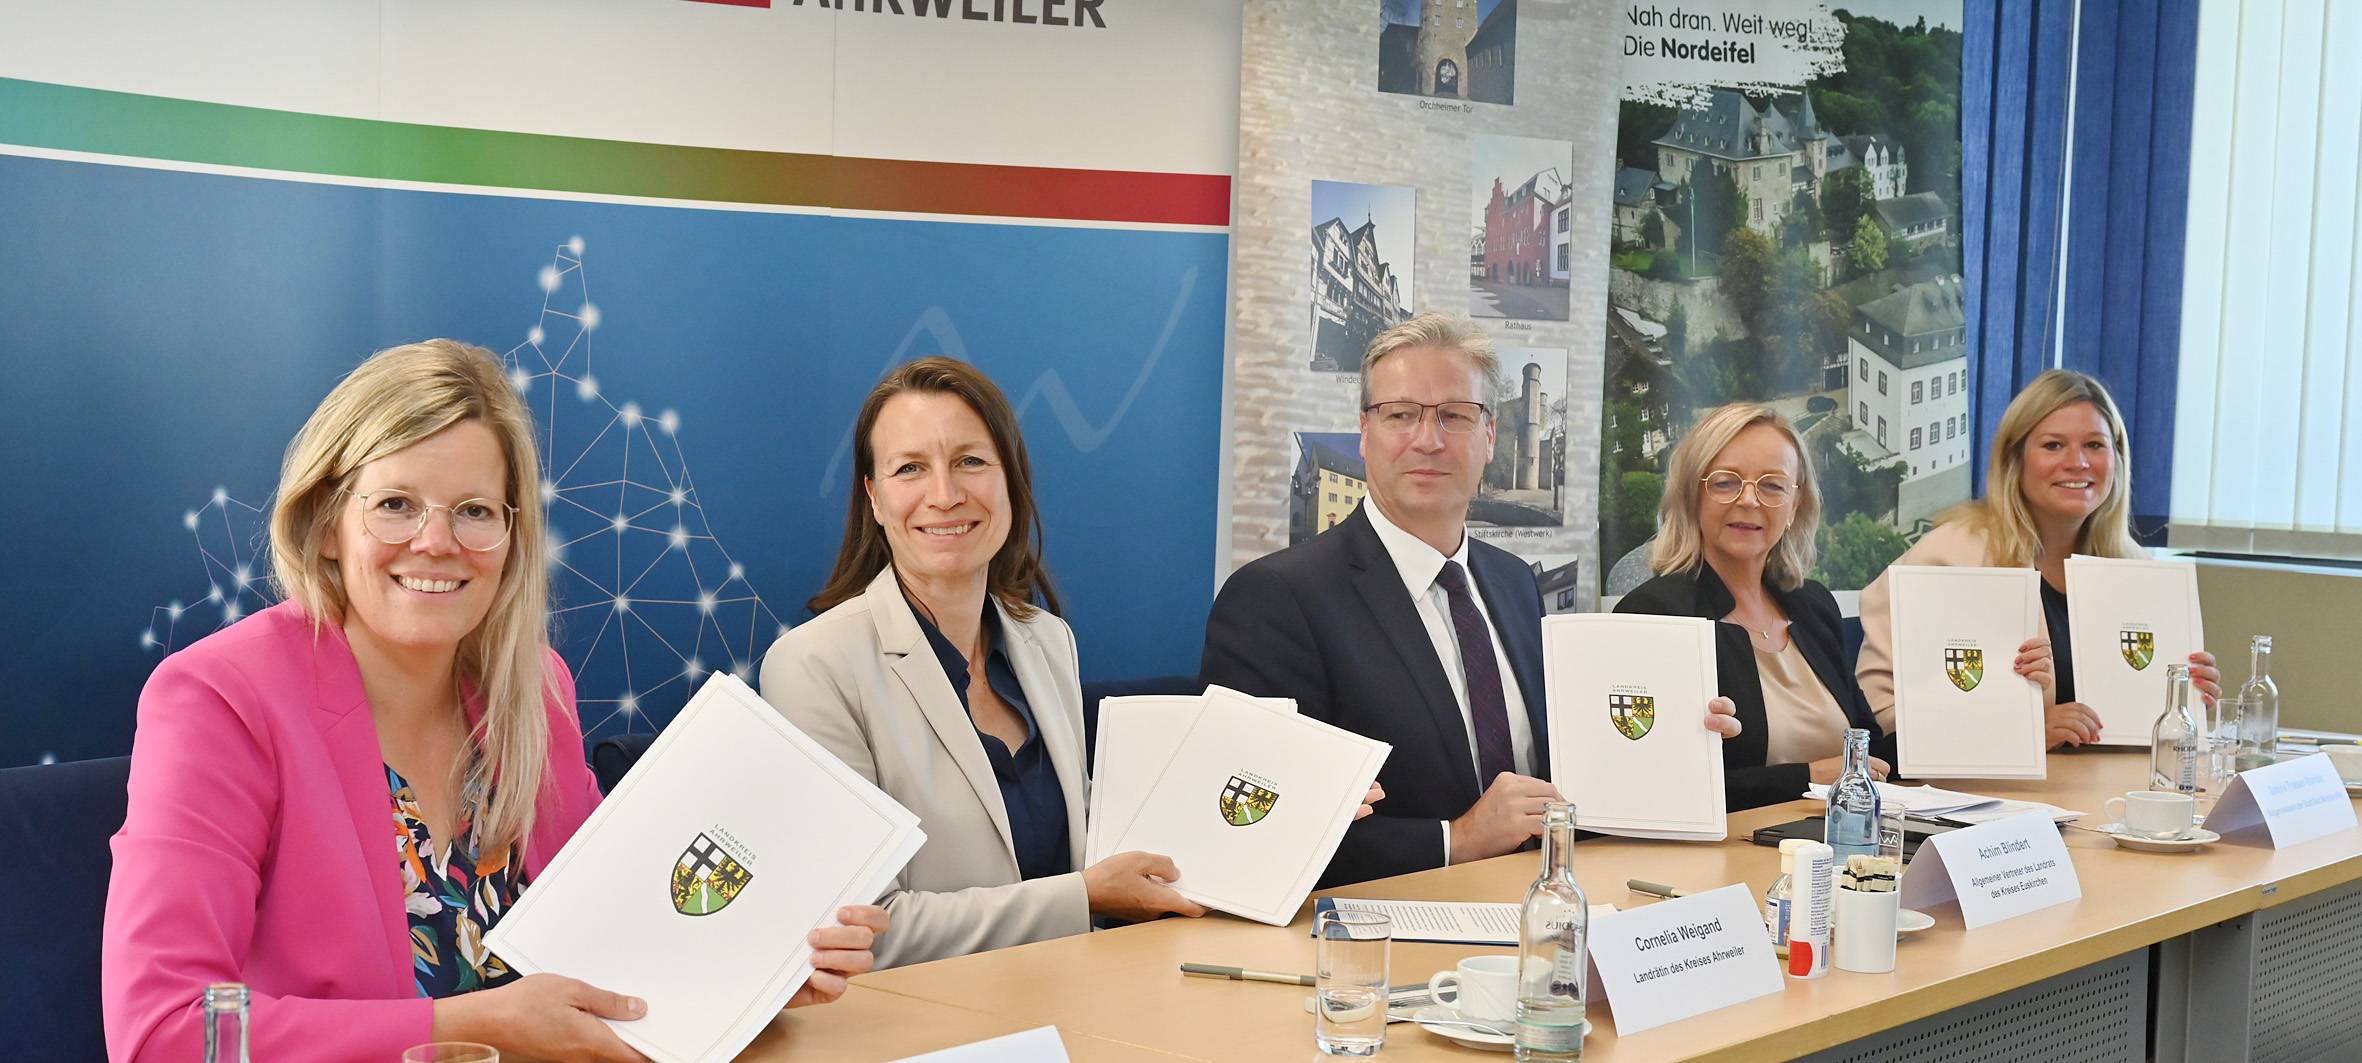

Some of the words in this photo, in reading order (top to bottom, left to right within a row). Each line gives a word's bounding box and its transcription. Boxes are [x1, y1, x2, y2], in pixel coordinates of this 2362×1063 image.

[1669, 7, 1716, 32] dran.
[1722, 12, 1763, 35] Weit
[1624, 35, 1655, 57] Die
[1661, 37, 1755, 64] Nordeifel
[1419, 100, 1460, 112] Orchheimer
[1462, 104, 1473, 114] Tor
[1505, 320, 1532, 330] Rathaus
[1335, 374, 1361, 384] Windec
[1474, 529, 1513, 538] Stiftskirche
[1515, 529, 1553, 538] (Westwerk)
[710, 829, 753, 866] AHRWEILER
[715, 823, 757, 860] LANDKREIS
[1978, 845, 2002, 860] Achim
[2000, 838, 2031, 854] Blindert
[1971, 873, 2001, 888] Allgemeiner
[2001, 867, 2024, 879] Vertreter
[2024, 864, 2034, 874] des
[2033, 859, 2056, 871] Landrats
[1991, 889, 2001, 899] des
[2001, 884, 2020, 896] Kreises
[2020, 877, 2048, 891] Euskirchen
[1635, 930, 1679, 952] Cornelia
[1676, 917, 1722, 940] Weigand
[1633, 965, 1669, 983] Landrätin
[1670, 963, 1684, 974] des
[1684, 954, 1712, 970] Kreises
[1712, 946, 1745, 962] Ahrweiler
